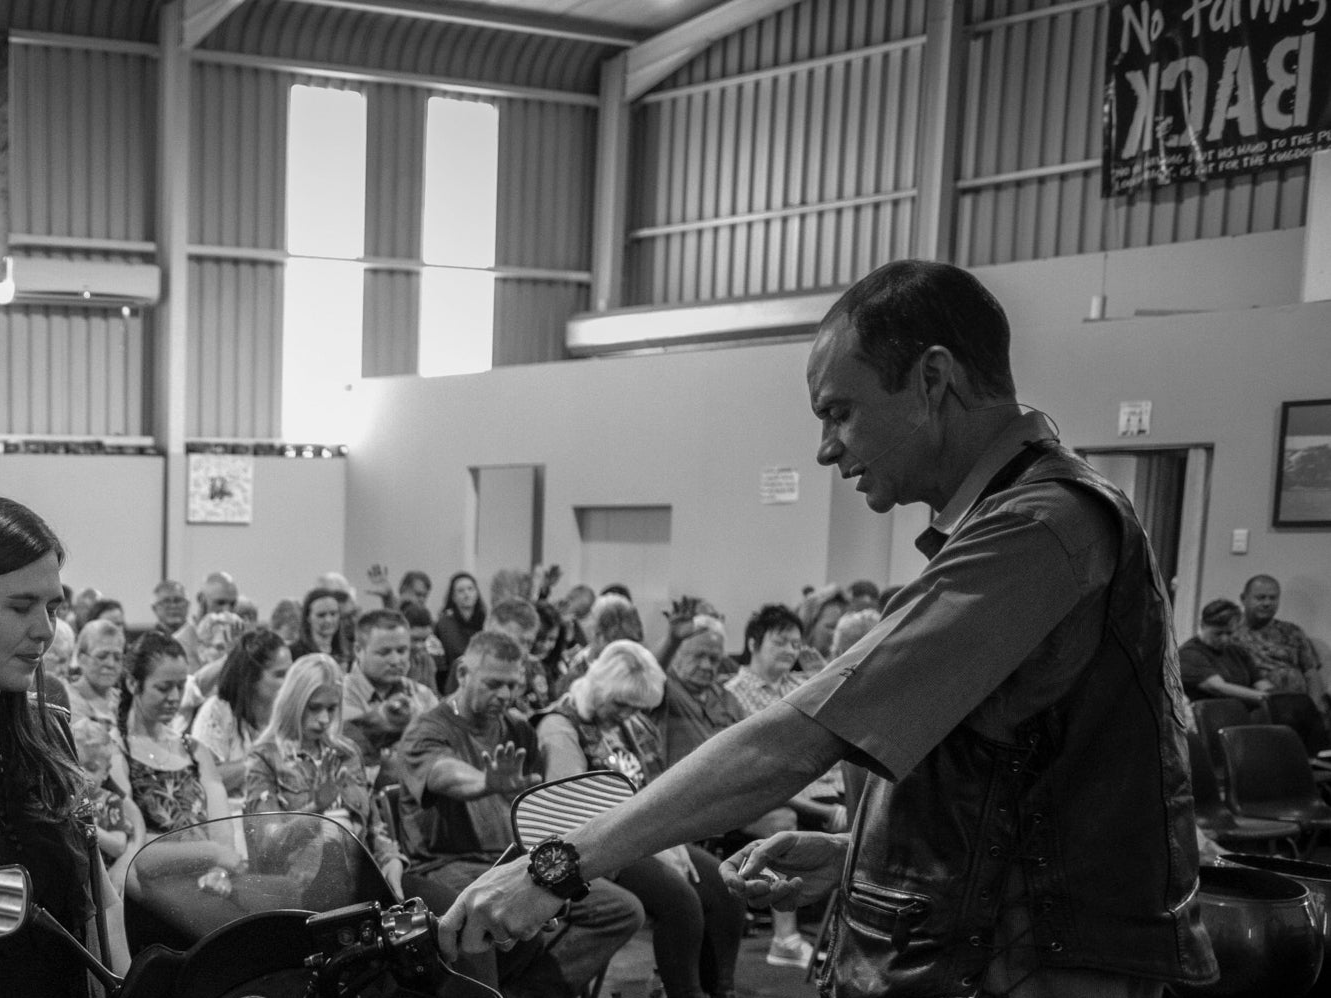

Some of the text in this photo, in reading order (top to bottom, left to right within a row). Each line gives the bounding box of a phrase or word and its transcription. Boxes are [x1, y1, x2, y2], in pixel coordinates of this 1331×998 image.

[1120, 0, 1165, 56] No
[1271, 137, 1288, 151] TO
[1290, 132, 1315, 147] THE
[1217, 158, 1240, 173] FOR
[1242, 153, 1268, 168] THE
